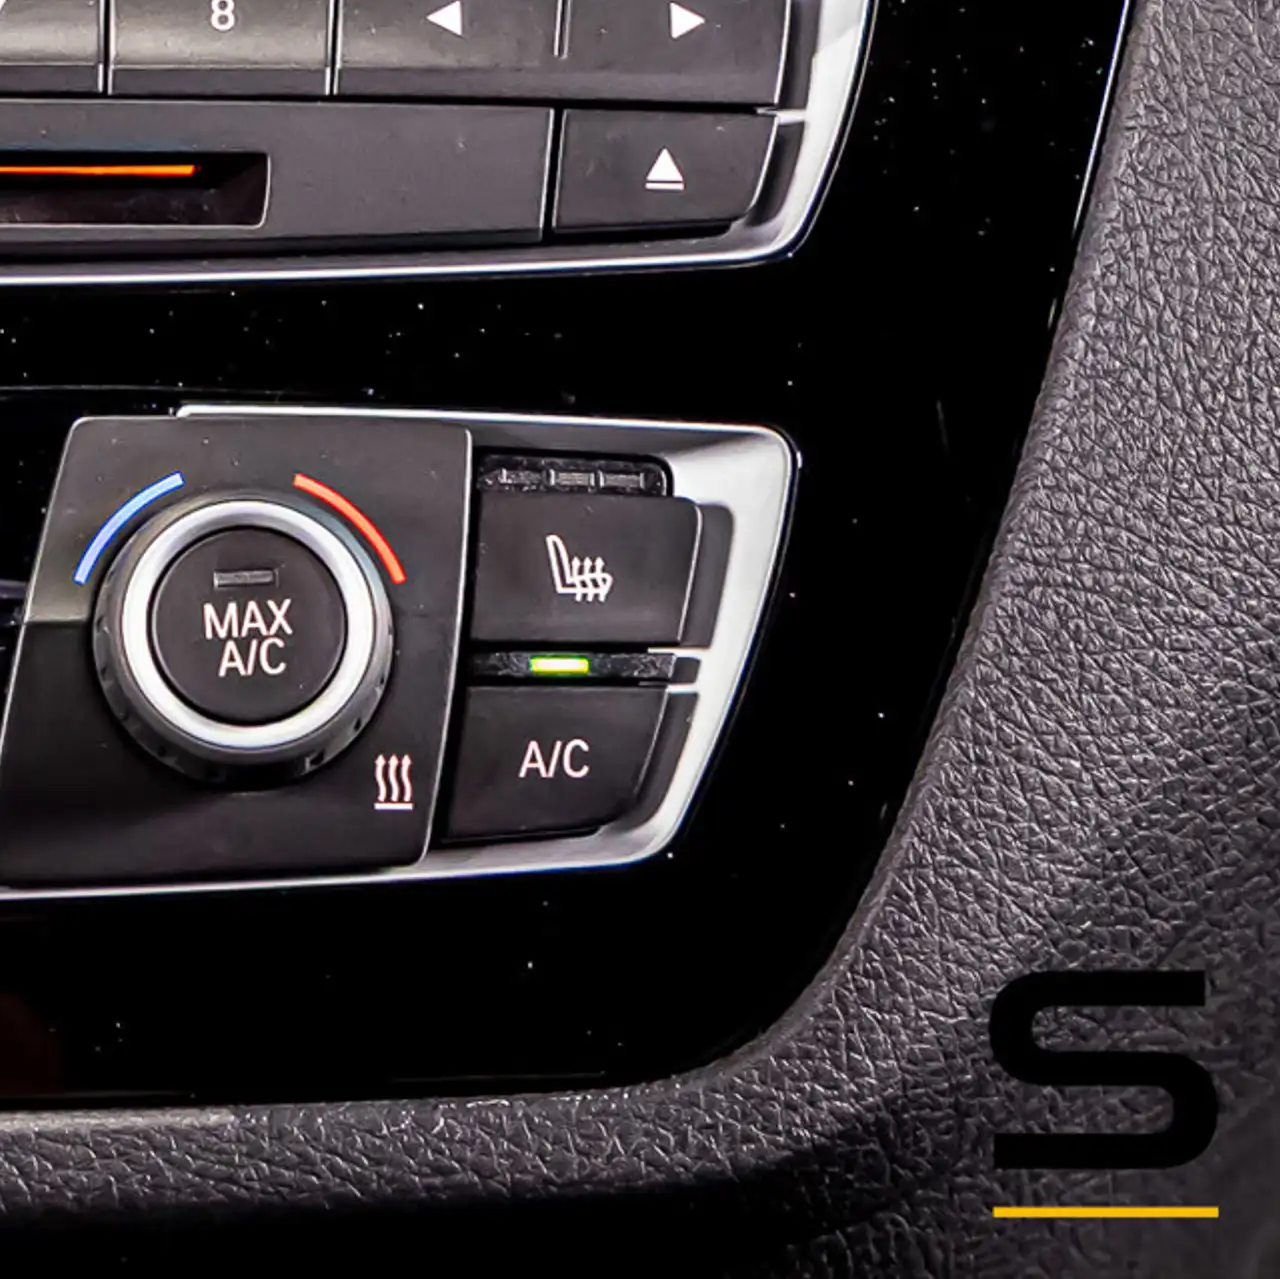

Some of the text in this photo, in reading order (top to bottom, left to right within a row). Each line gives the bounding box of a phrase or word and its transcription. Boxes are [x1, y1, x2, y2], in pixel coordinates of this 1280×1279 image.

[204, 599, 293, 640] MAX
[219, 636, 286, 677] A/C
[519, 739, 589, 777] A/C
